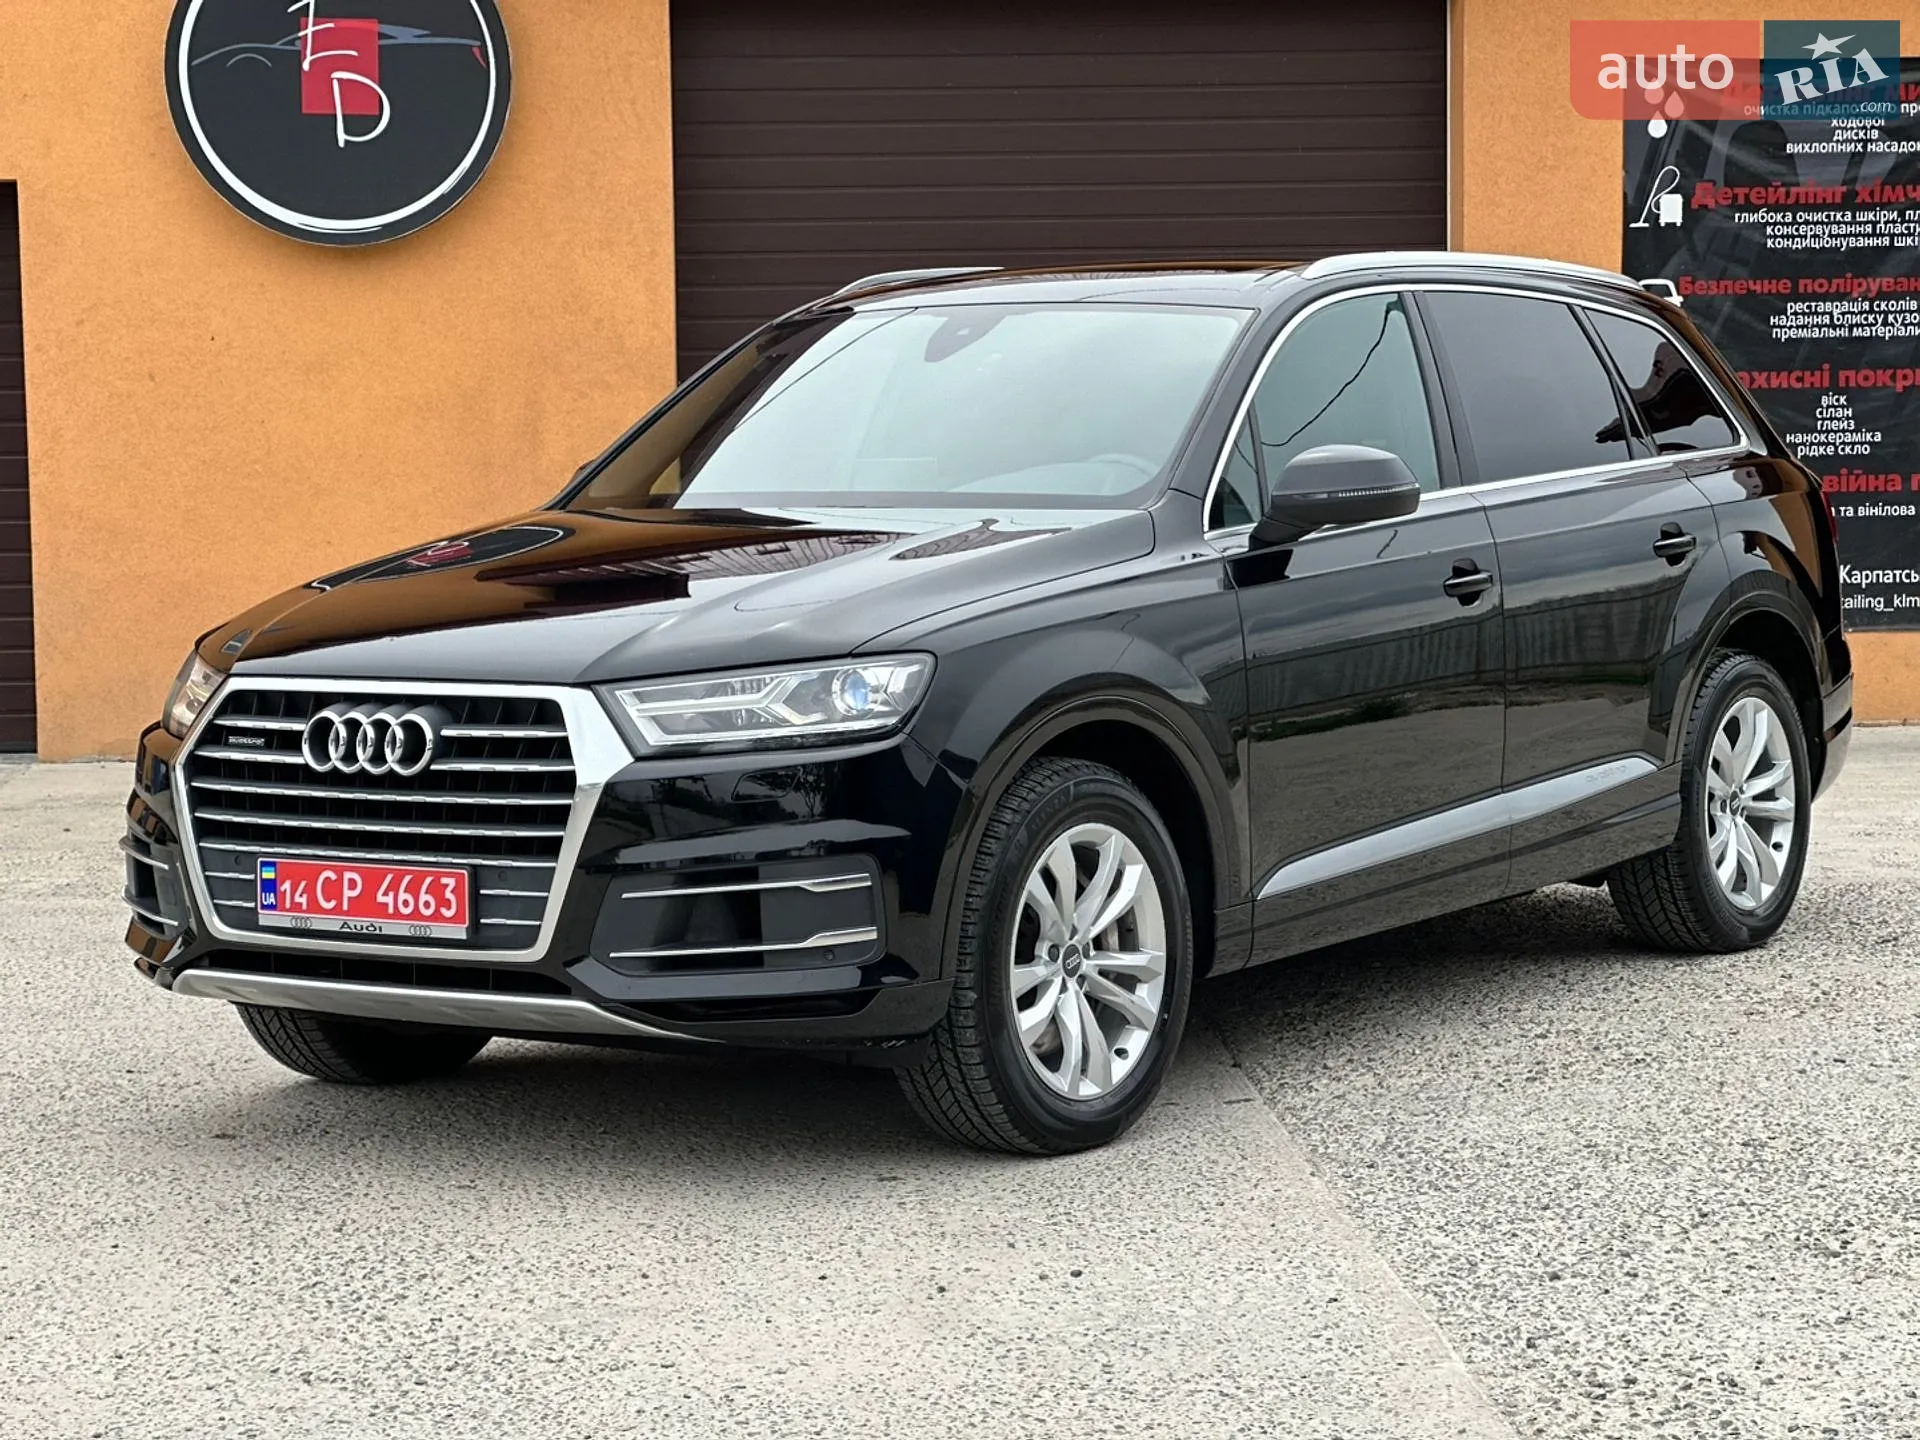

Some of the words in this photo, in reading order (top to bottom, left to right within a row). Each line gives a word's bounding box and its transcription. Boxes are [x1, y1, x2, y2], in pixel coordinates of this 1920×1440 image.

[1833, 127, 1879, 141] дисків
[1786, 141, 1863, 153] вихлопних
[1690, 178, 1847, 210] Детейлінг
[1734, 208, 1792, 223] глибока
[1796, 211, 1852, 222] очистка
[1856, 207, 1901, 224] шкіри,
[1766, 222, 1872, 237] консервування
[1767, 235, 1890, 251] кондиціонування
[1679, 275, 1792, 295] Безпечне
[1787, 298, 1869, 315] реставрація
[1873, 297, 1917, 311] сколів
[1770, 314, 1830, 327] надання
[1833, 311, 1884, 328] блиску
[1888, 313, 1919, 328] кузо
[1772, 324, 1849, 341] преміальні
[1821, 392, 1847, 406] віск
[1816, 404, 1852, 418] сілан
[1817, 418, 1855, 431] глейз
[1786, 429, 1881, 445] нанокераміка
[1797, 443, 1836, 459] рідке
[1838, 444, 1870, 455] скло
[1839, 506, 1854, 517] та
[1858, 502, 1916, 517] вінілова
[1840, 564, 1920, 589] Карпатсь
[262, 892, 276, 905] UA
[376, 873, 458, 918] 4663
[339, 921, 383, 933] Audi
